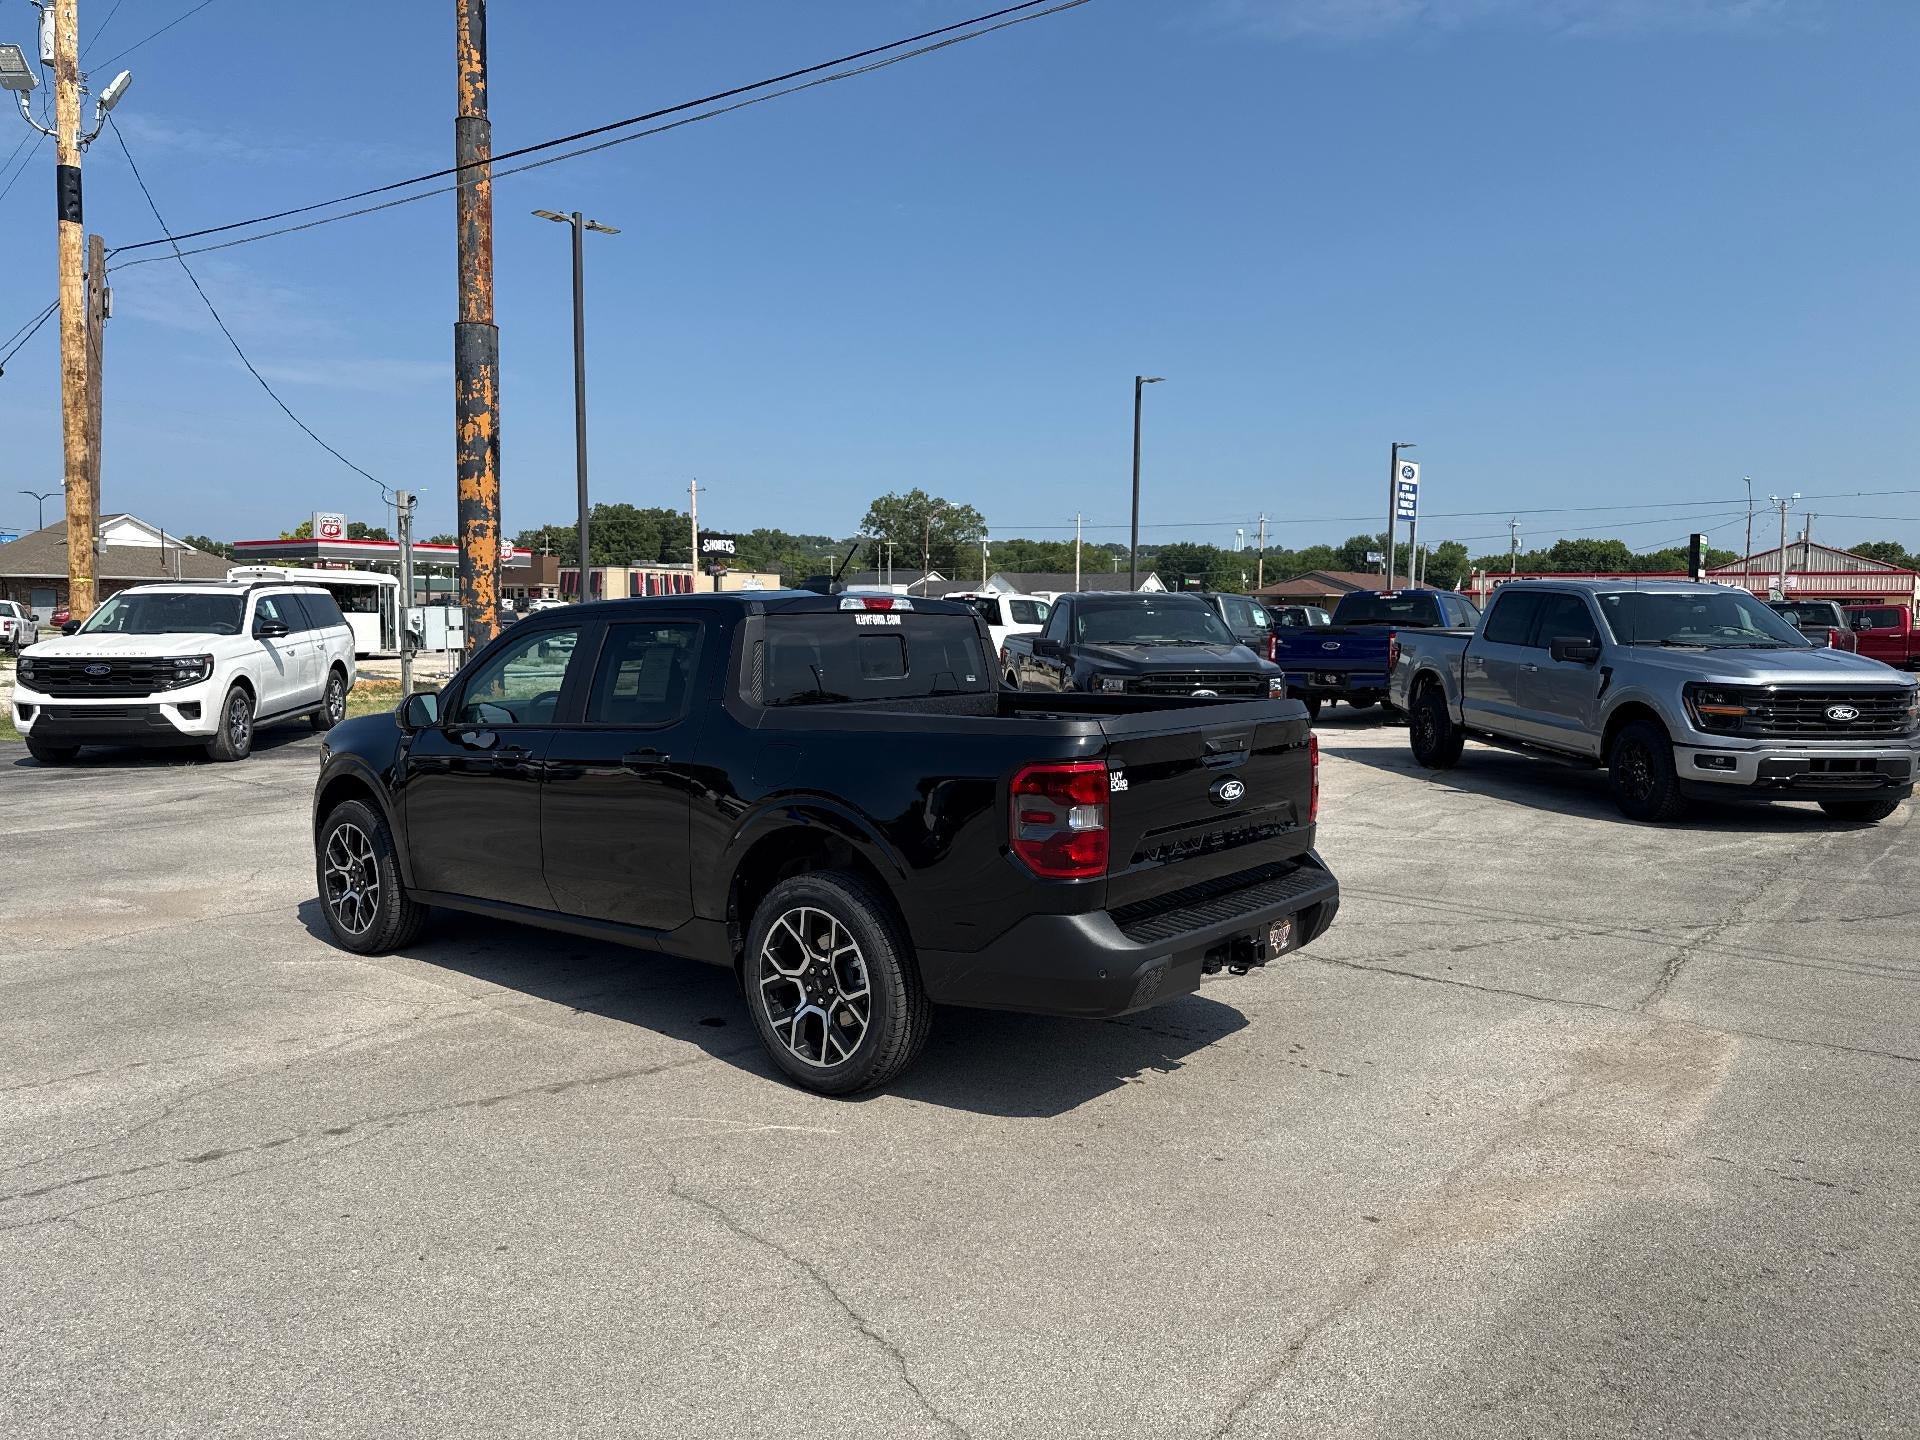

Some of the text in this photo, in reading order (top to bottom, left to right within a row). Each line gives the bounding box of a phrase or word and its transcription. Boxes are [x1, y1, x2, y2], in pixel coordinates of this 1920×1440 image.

[323, 525, 340, 534] 66
[1110, 771, 1123, 781] LUV
[1110, 779, 1128, 789] FORD
[1224, 783, 1241, 798] Ford
[1143, 818, 1296, 862] MAVER
